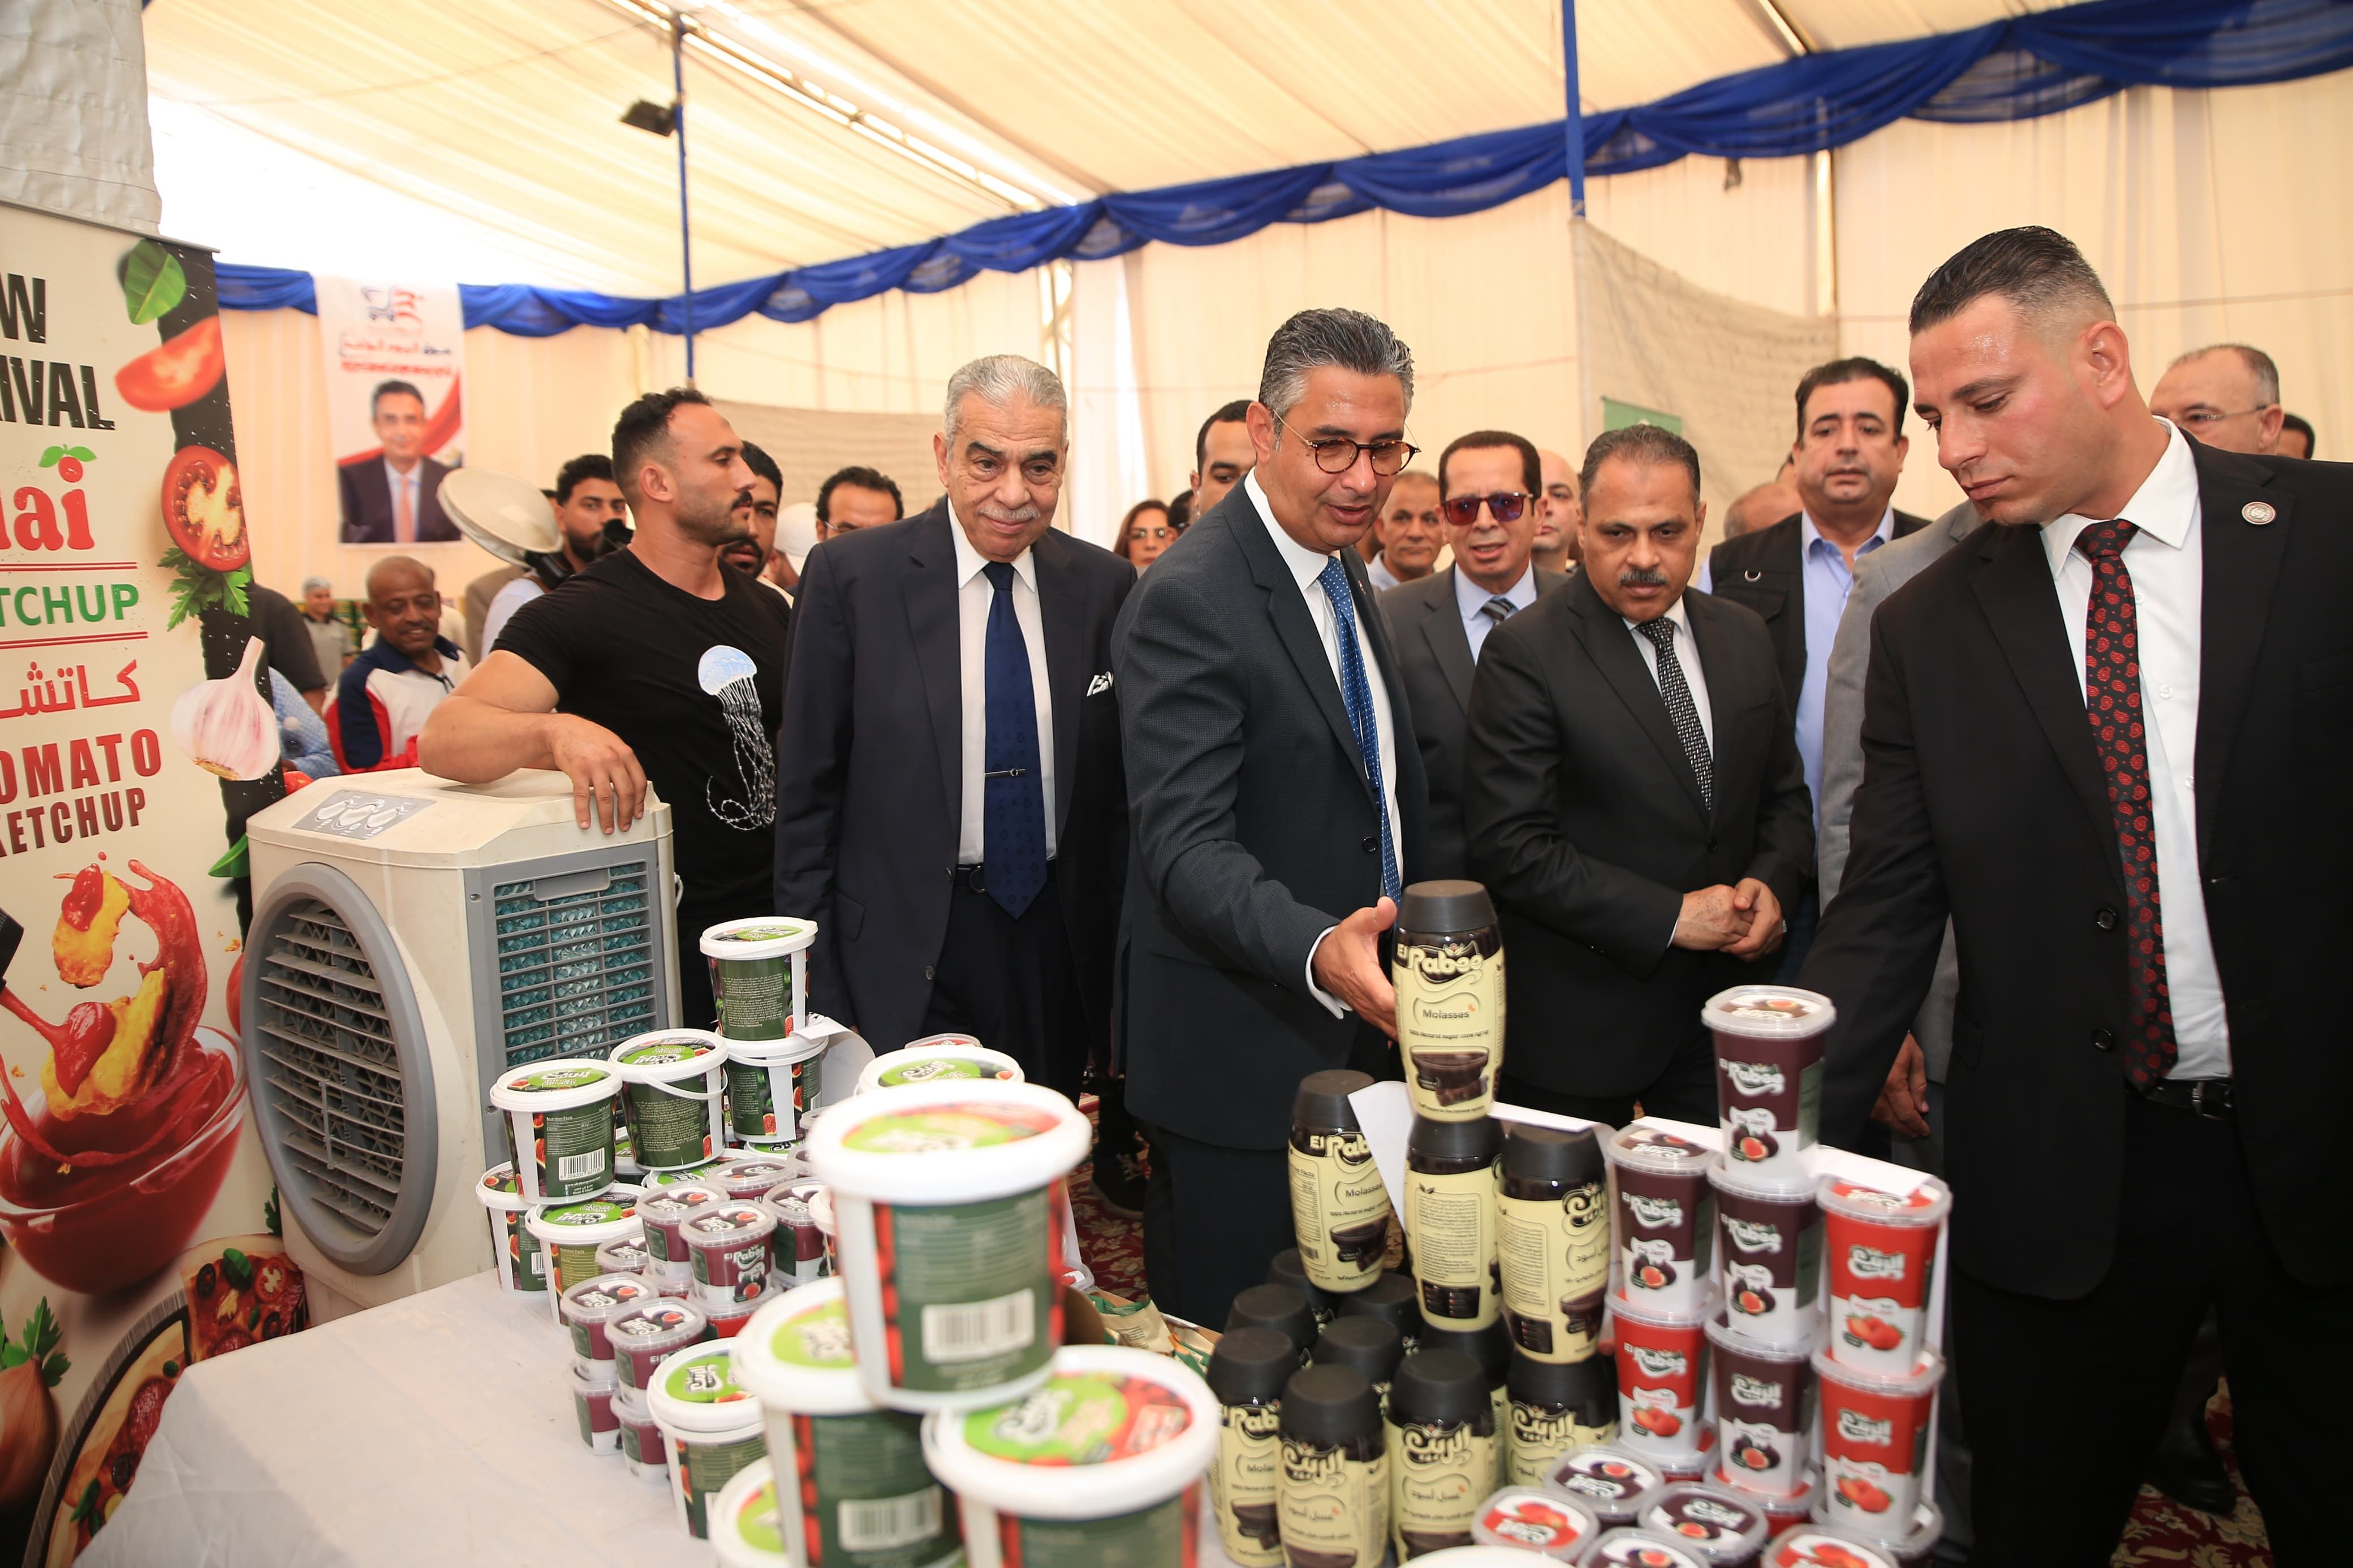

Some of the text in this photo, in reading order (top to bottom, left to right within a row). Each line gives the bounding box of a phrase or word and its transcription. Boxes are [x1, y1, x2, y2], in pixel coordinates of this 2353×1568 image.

[0, 355, 116, 431] IVAL
[0, 456, 95, 551] ai
[0, 787, 146, 858] ETCHUP
[1397, 943, 1484, 983] El Rabee
[1422, 1008, 1470, 1019] Molasses
[1309, 1132, 1369, 1169] El Rab
[1346, 1183, 1383, 1198] Molasses
[1630, 1196, 1684, 1227] Rabee
[1632, 1346, 1687, 1377] Rabee
[1223, 1406, 1279, 1443] Rab
[1402, 1424, 1471, 1468] الربيع
[1247, 1464, 1276, 1472] Mola
[1283, 1444, 1347, 1486] الربيع
